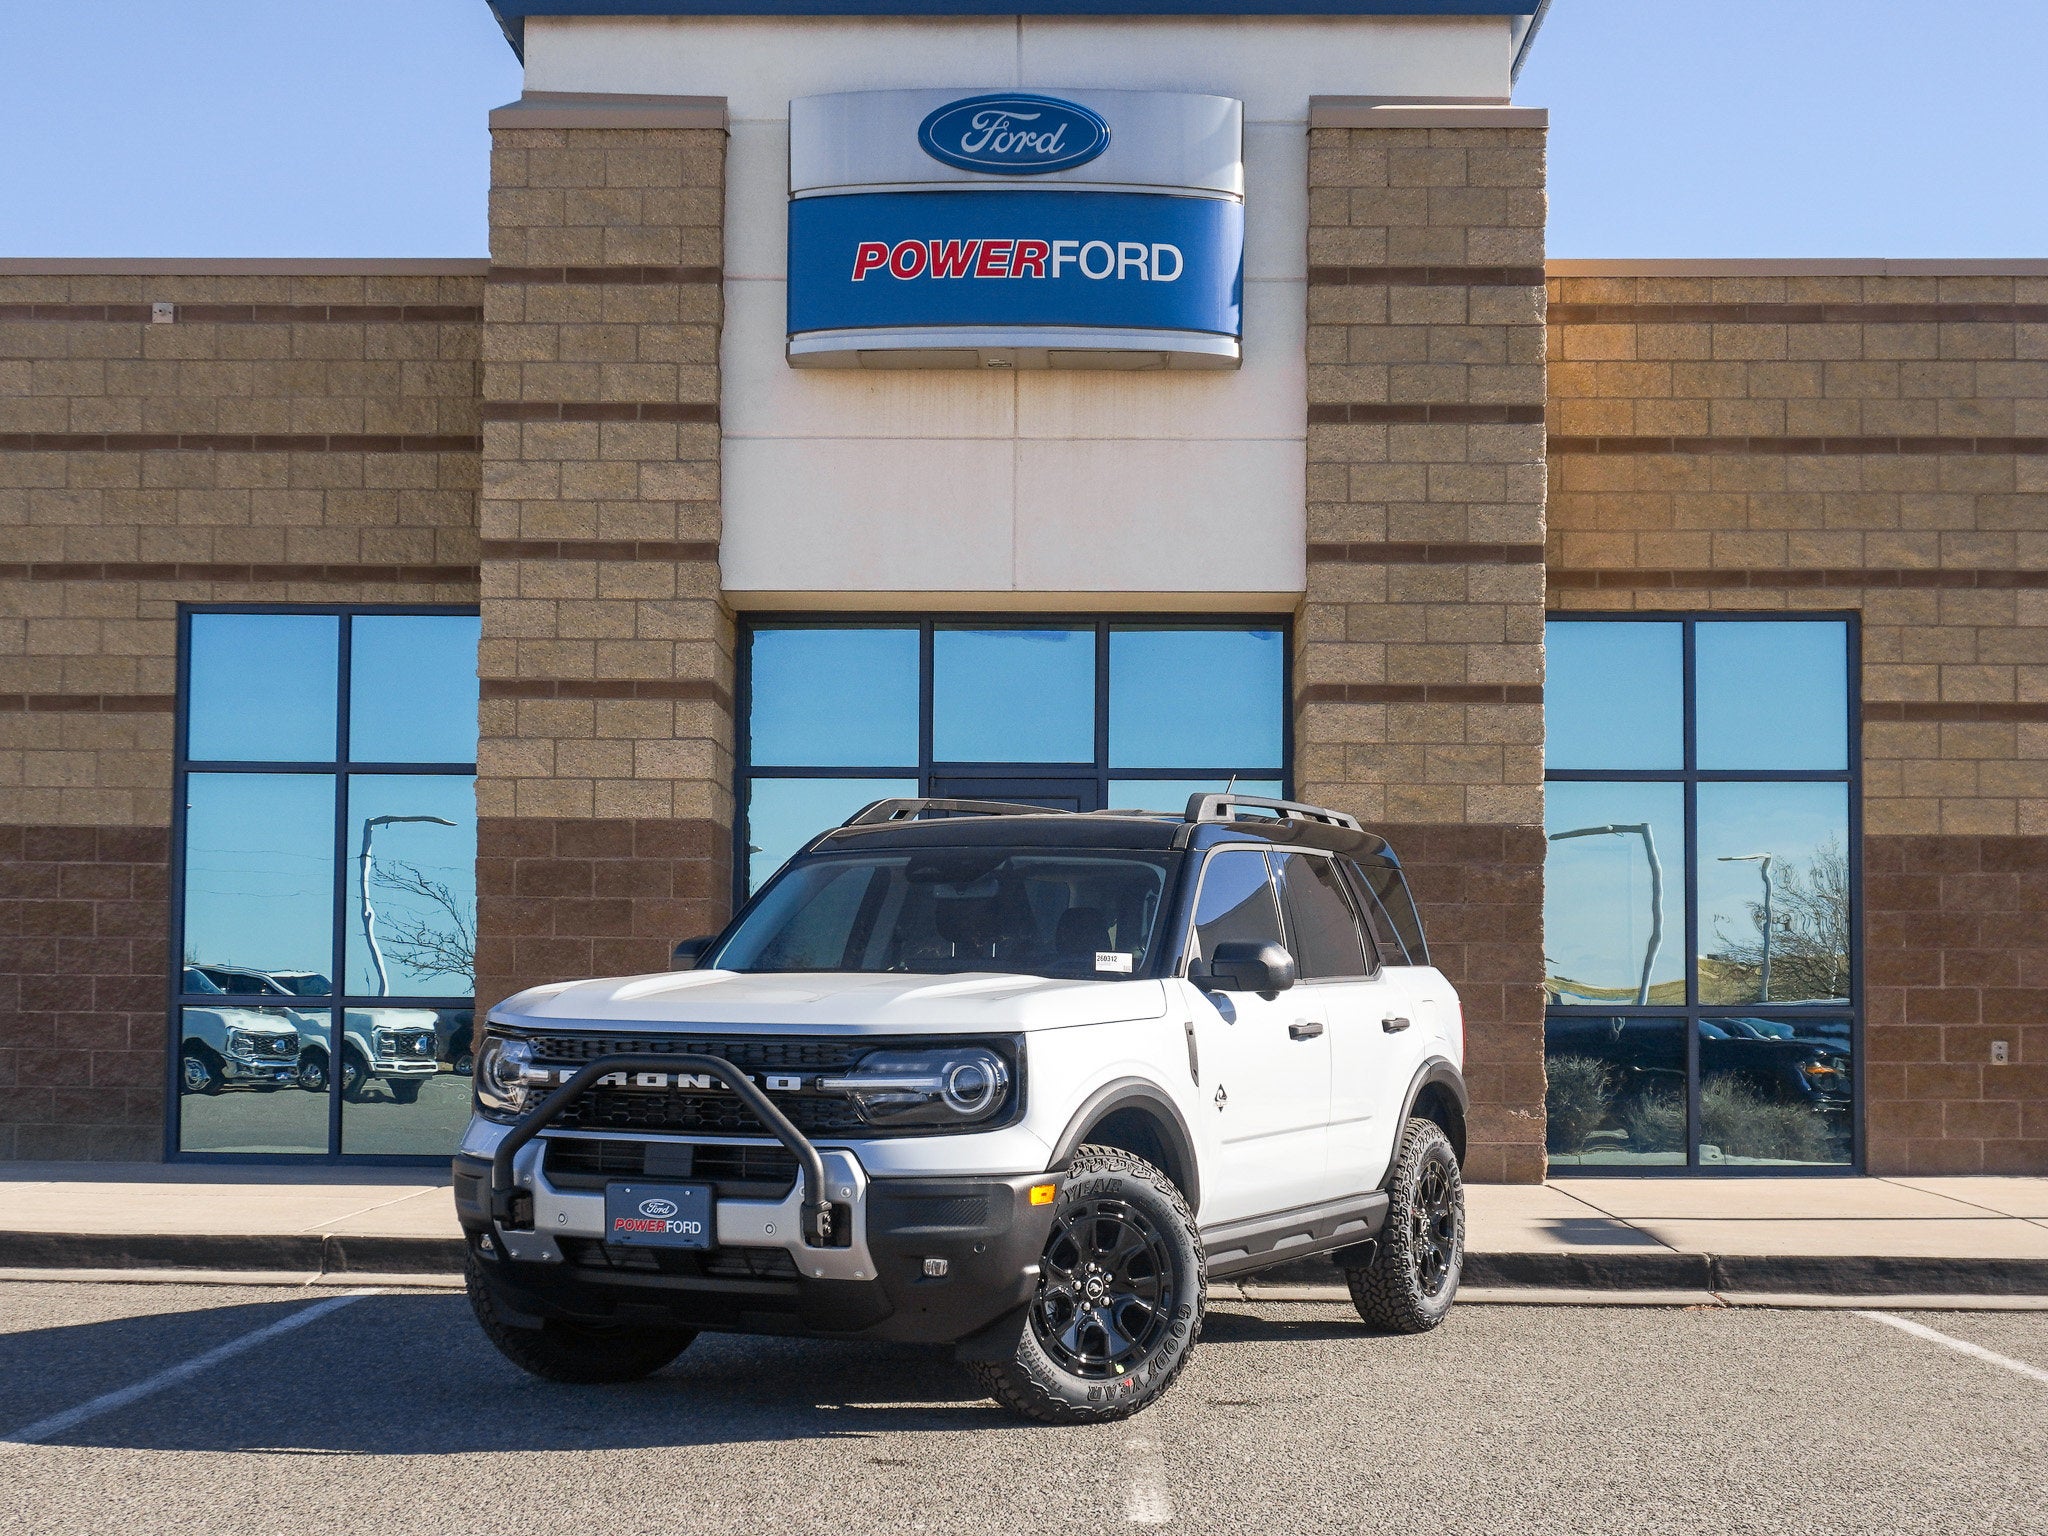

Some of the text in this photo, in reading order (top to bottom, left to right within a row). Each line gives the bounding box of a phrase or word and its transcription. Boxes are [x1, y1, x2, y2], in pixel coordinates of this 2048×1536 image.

[960, 110, 1069, 155] Ford
[851, 238, 1184, 282] POWERFORD
[559, 1069, 801, 1091] RONO
[614, 1217, 702, 1234] POWERFORD
[646, 1202, 670, 1215] Ford
[1019, 1339, 1064, 1393] TERRITOR
[1087, 1303, 1192, 1401] GOODYEAR
